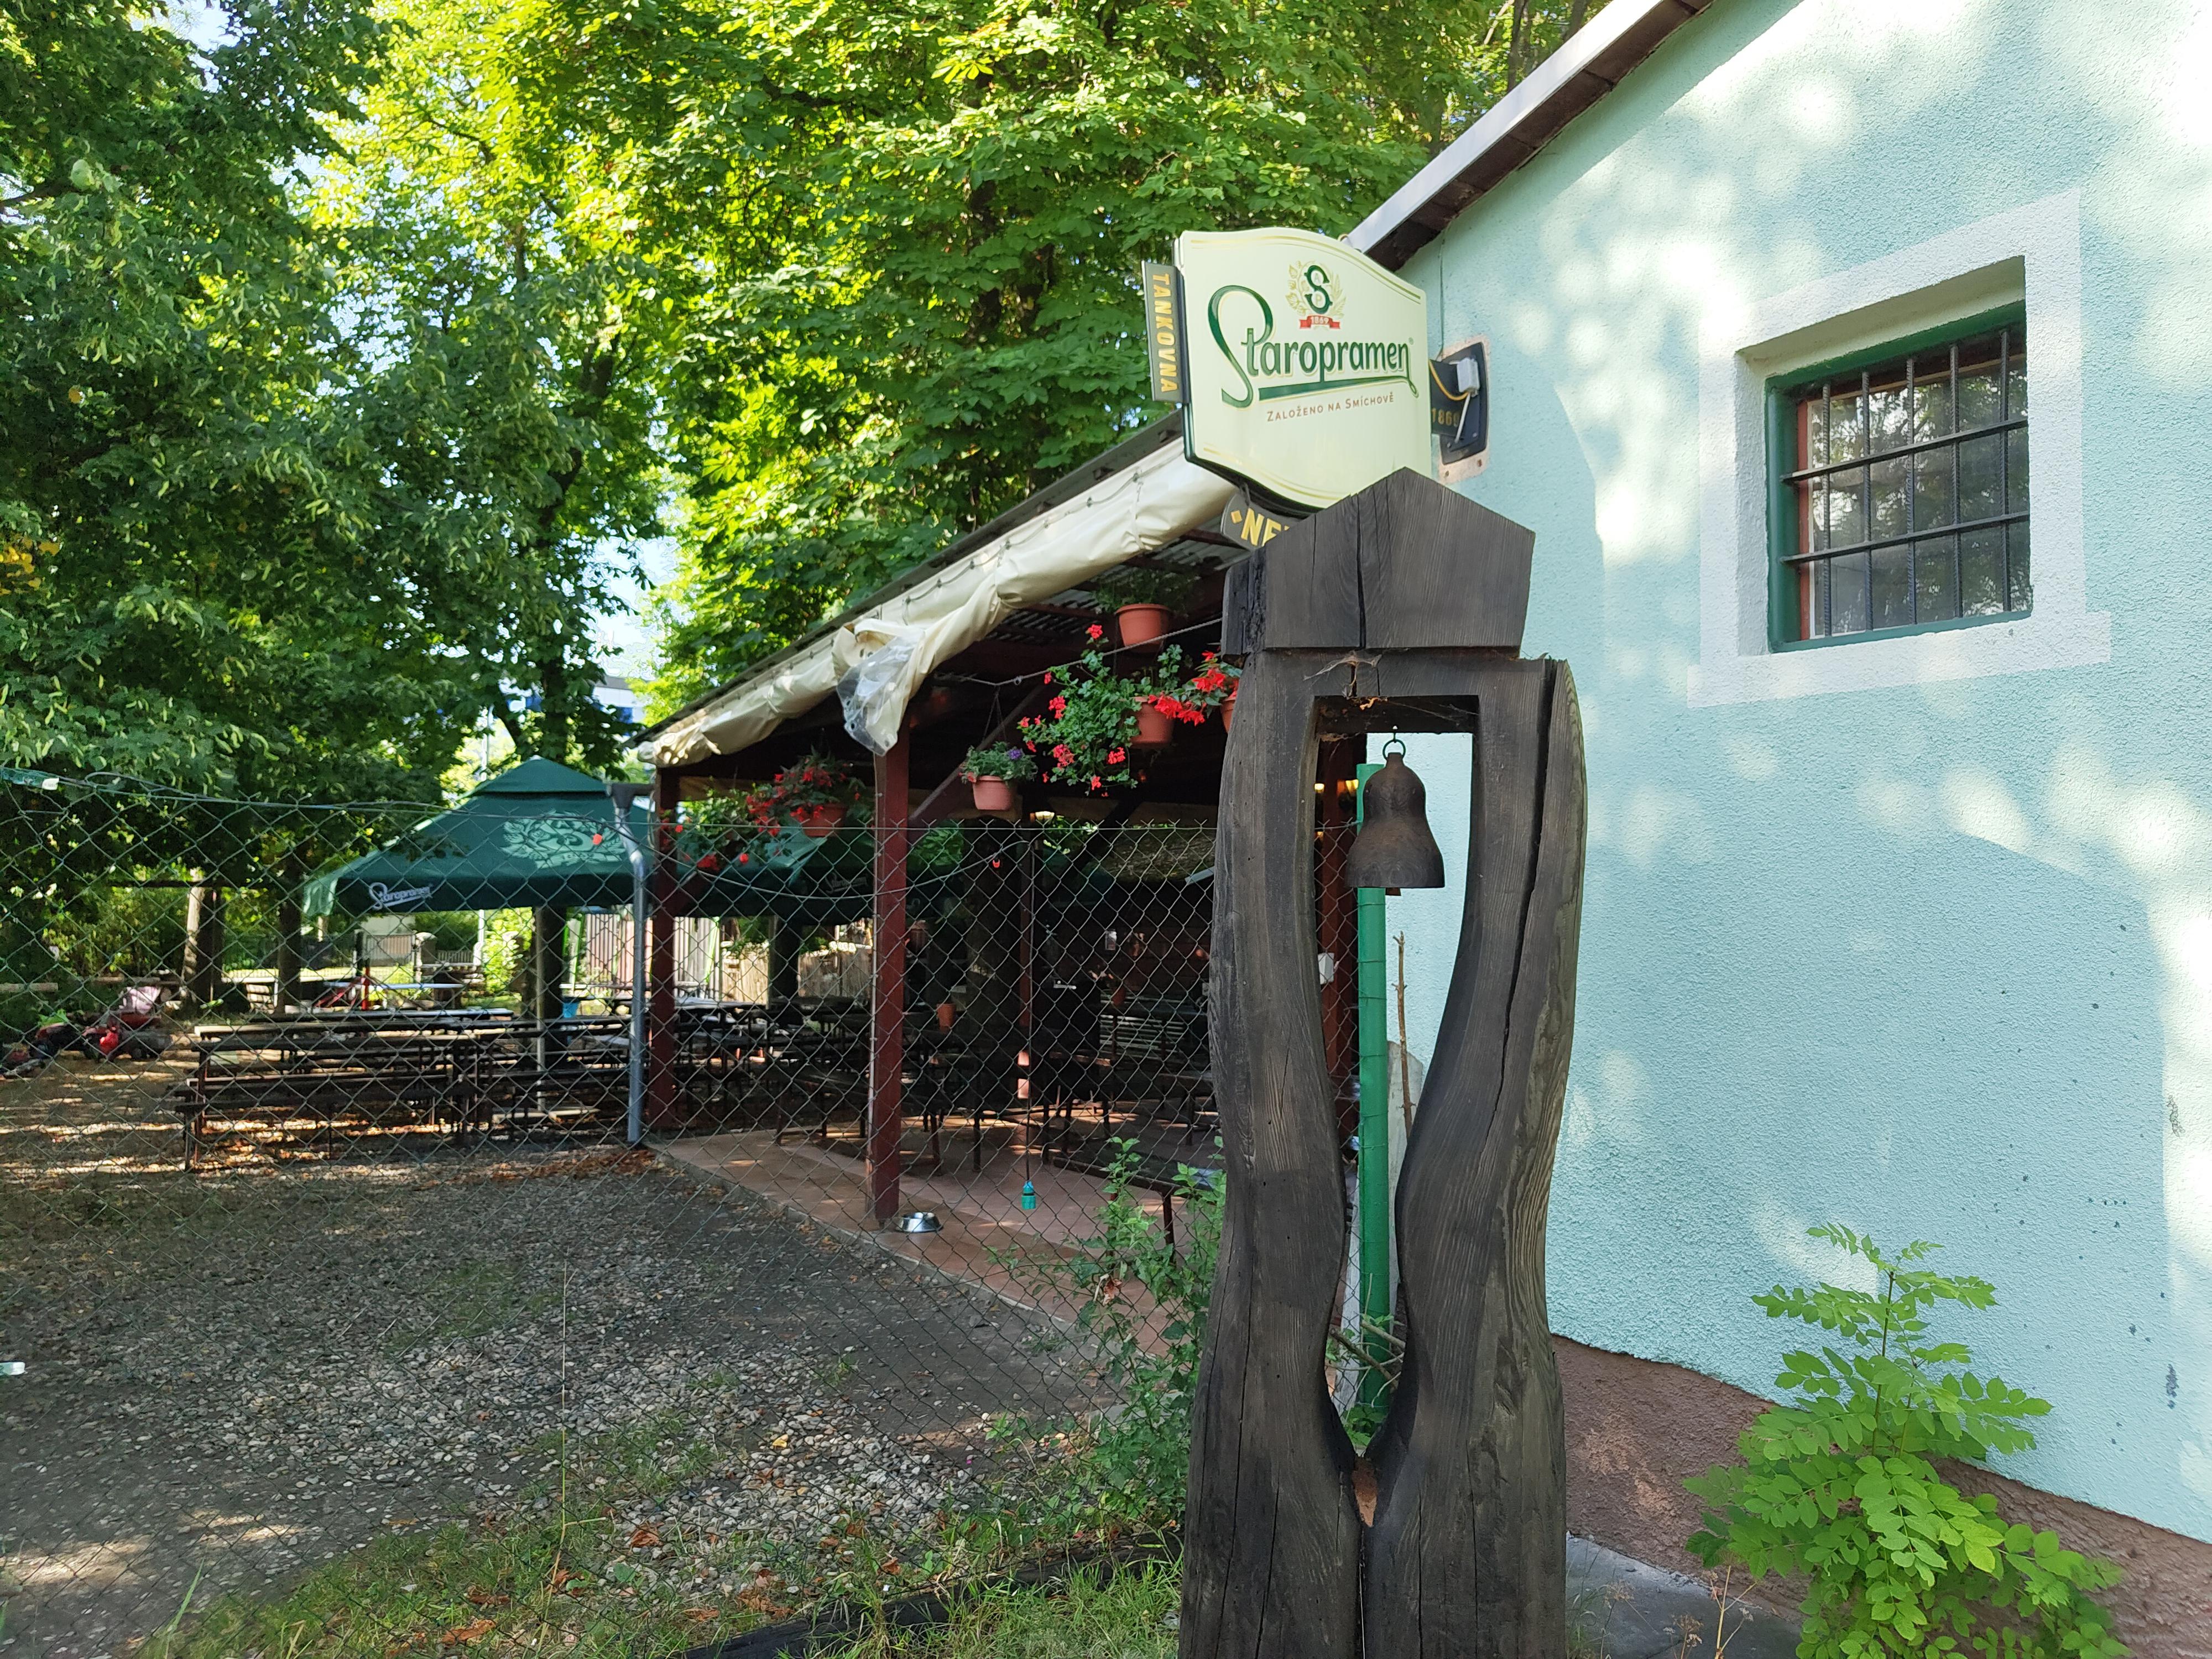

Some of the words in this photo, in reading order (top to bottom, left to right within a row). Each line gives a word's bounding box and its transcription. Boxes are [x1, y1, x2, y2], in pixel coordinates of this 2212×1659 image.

[1152, 273, 1178, 392] TANKOVNA
[1208, 284, 1418, 408] Staropramen
[1310, 316, 1329, 325] 1869
